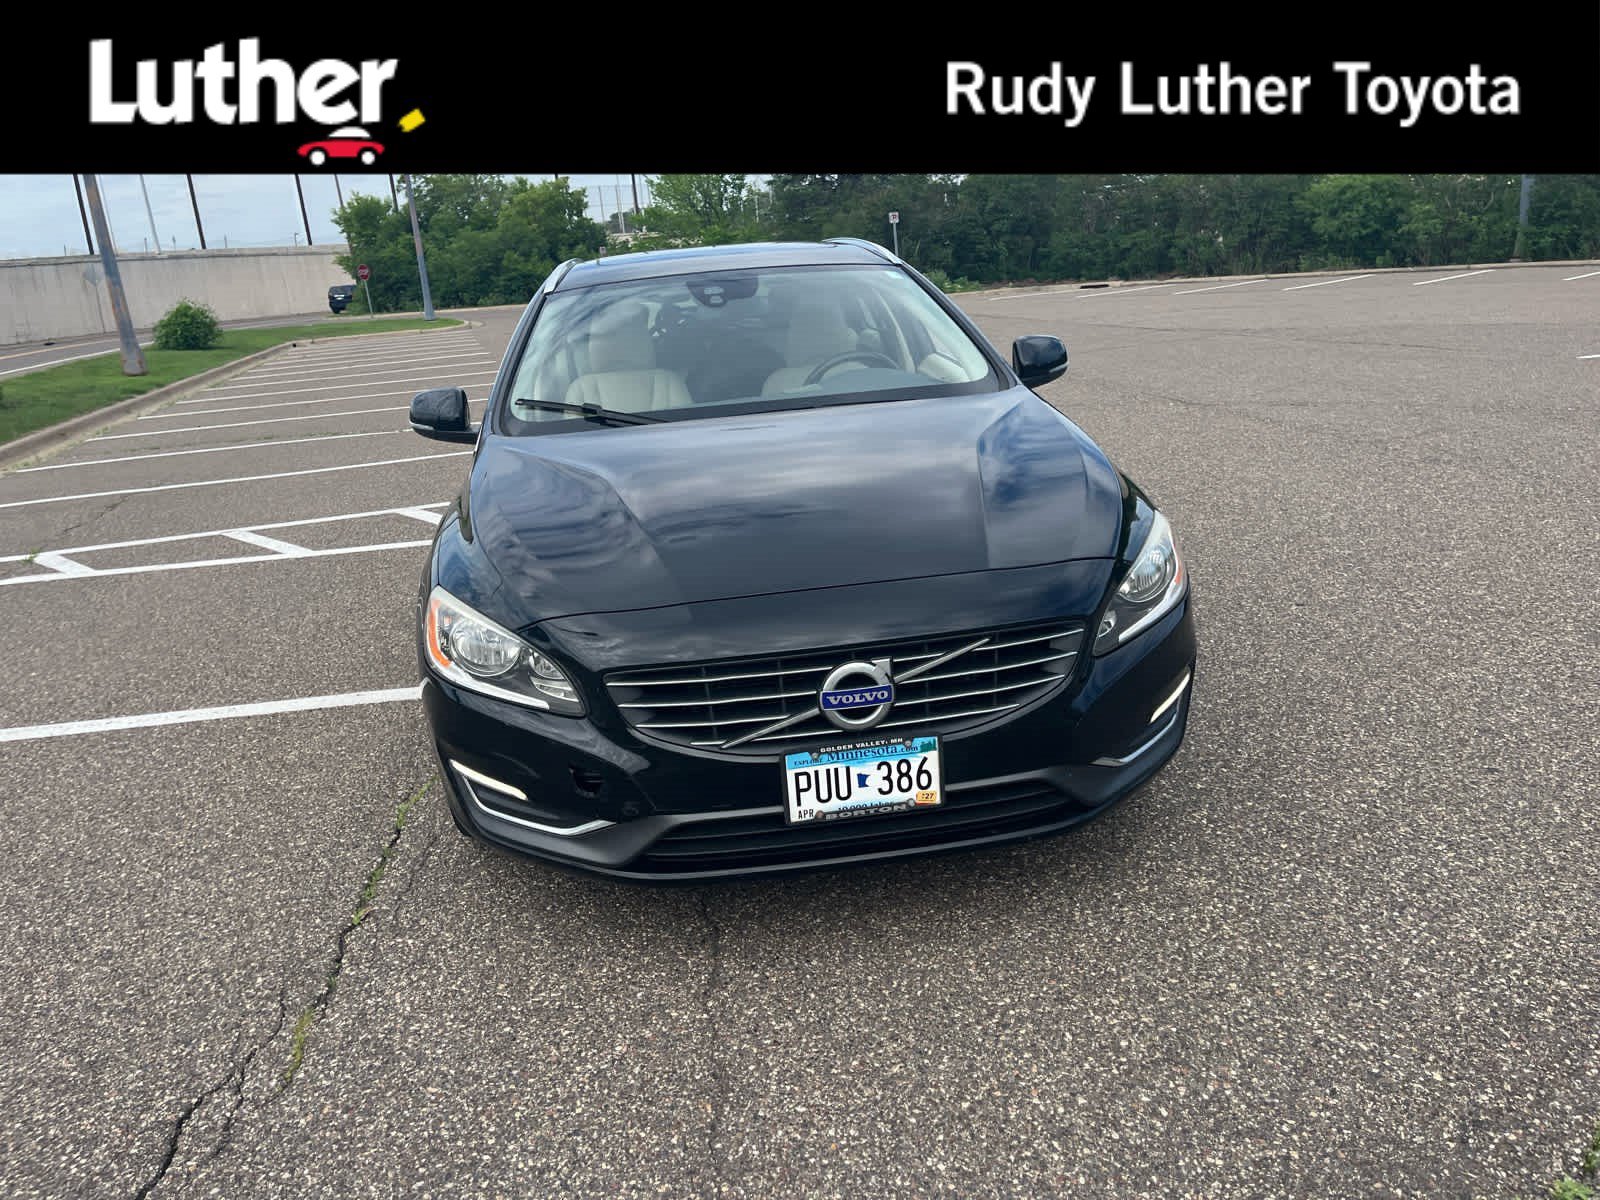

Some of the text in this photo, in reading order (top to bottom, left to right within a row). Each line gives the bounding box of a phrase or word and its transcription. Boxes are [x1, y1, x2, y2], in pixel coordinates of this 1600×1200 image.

[826, 690, 889, 705] VOLVO
[820, 744, 853, 753] GOLDEN
[794, 756, 932, 807] PUU 386
[798, 809, 814, 820] APR
